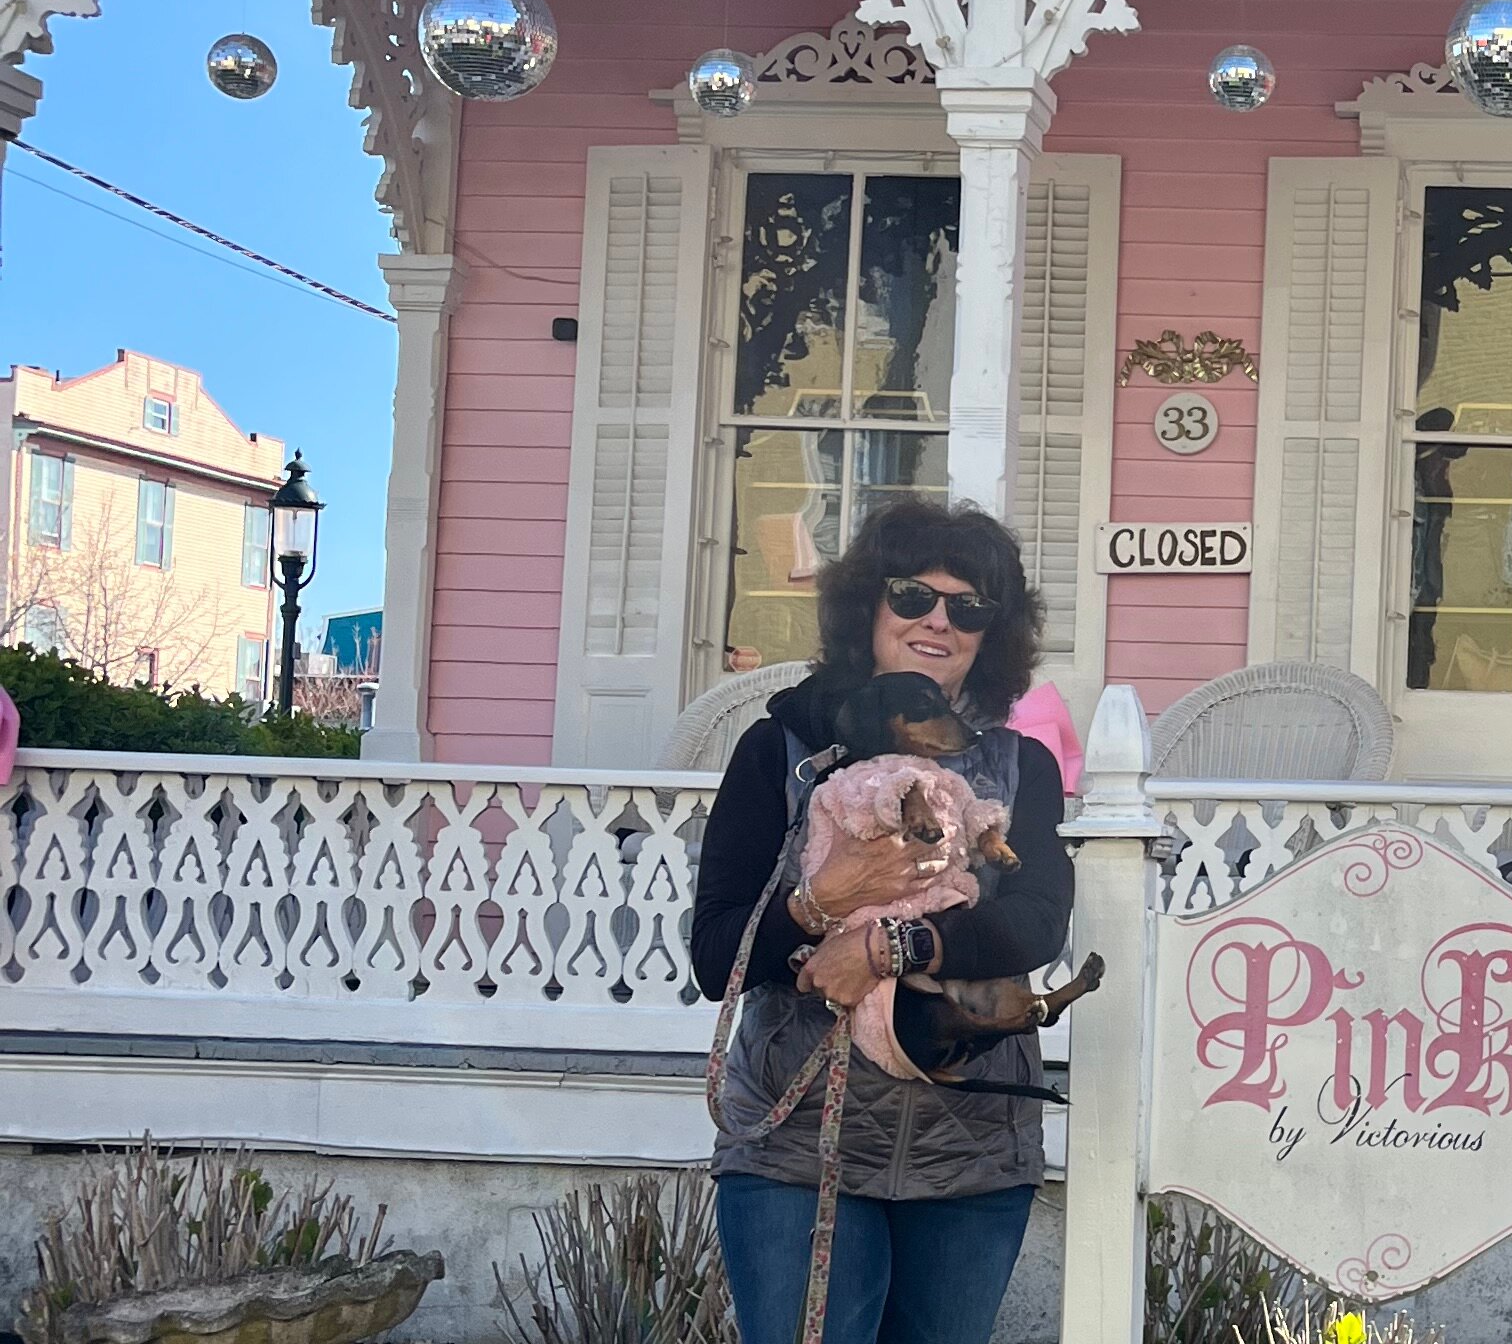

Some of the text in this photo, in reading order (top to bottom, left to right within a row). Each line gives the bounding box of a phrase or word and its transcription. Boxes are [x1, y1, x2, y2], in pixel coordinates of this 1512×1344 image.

[1160, 406, 1210, 442] 33
[1109, 528, 1247, 568] CLOSED
[1268, 1072, 1486, 1161] by Victorious
